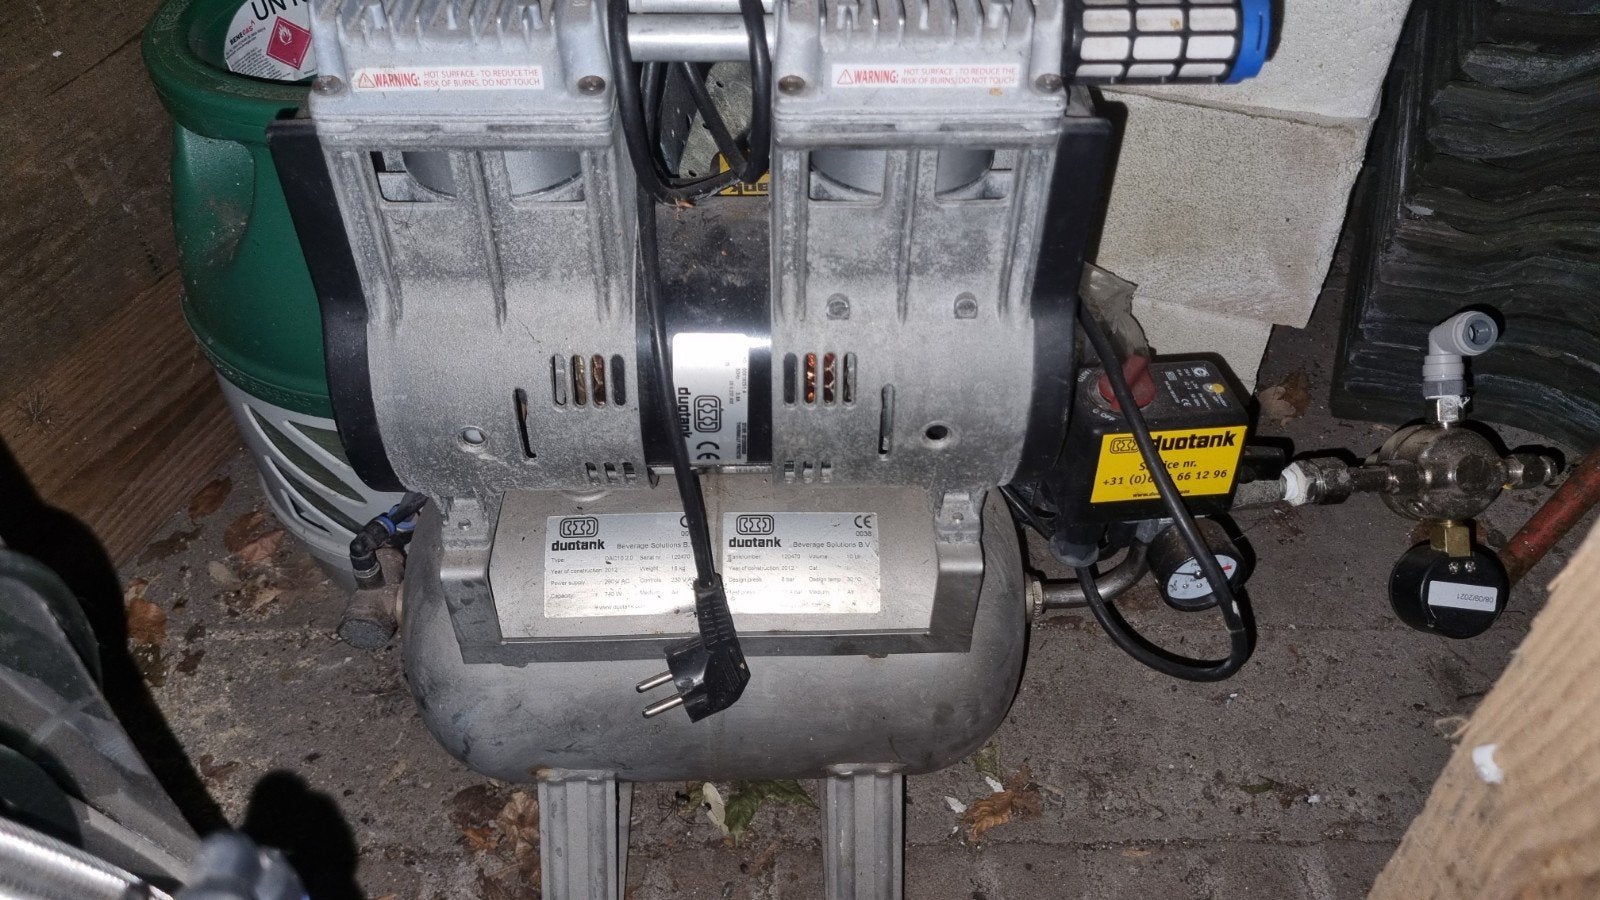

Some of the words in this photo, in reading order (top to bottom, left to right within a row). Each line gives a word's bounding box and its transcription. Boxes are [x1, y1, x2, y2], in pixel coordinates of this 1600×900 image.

[374, 72, 421, 88] WARNING:
[442, 70, 475, 78] SURFACE
[854, 70, 899, 83] WARNING:
[1152, 431, 1236, 450] duotank
[1140, 460, 1179, 470] Sice
[1103, 476, 1123, 486] +31
[1177, 472, 1191, 481] 66
[1196, 471, 1208, 479] 12
[1213, 470, 1227, 478] 96
[551, 539, 605, 551] duotank
[729, 537, 781, 548] duotank
